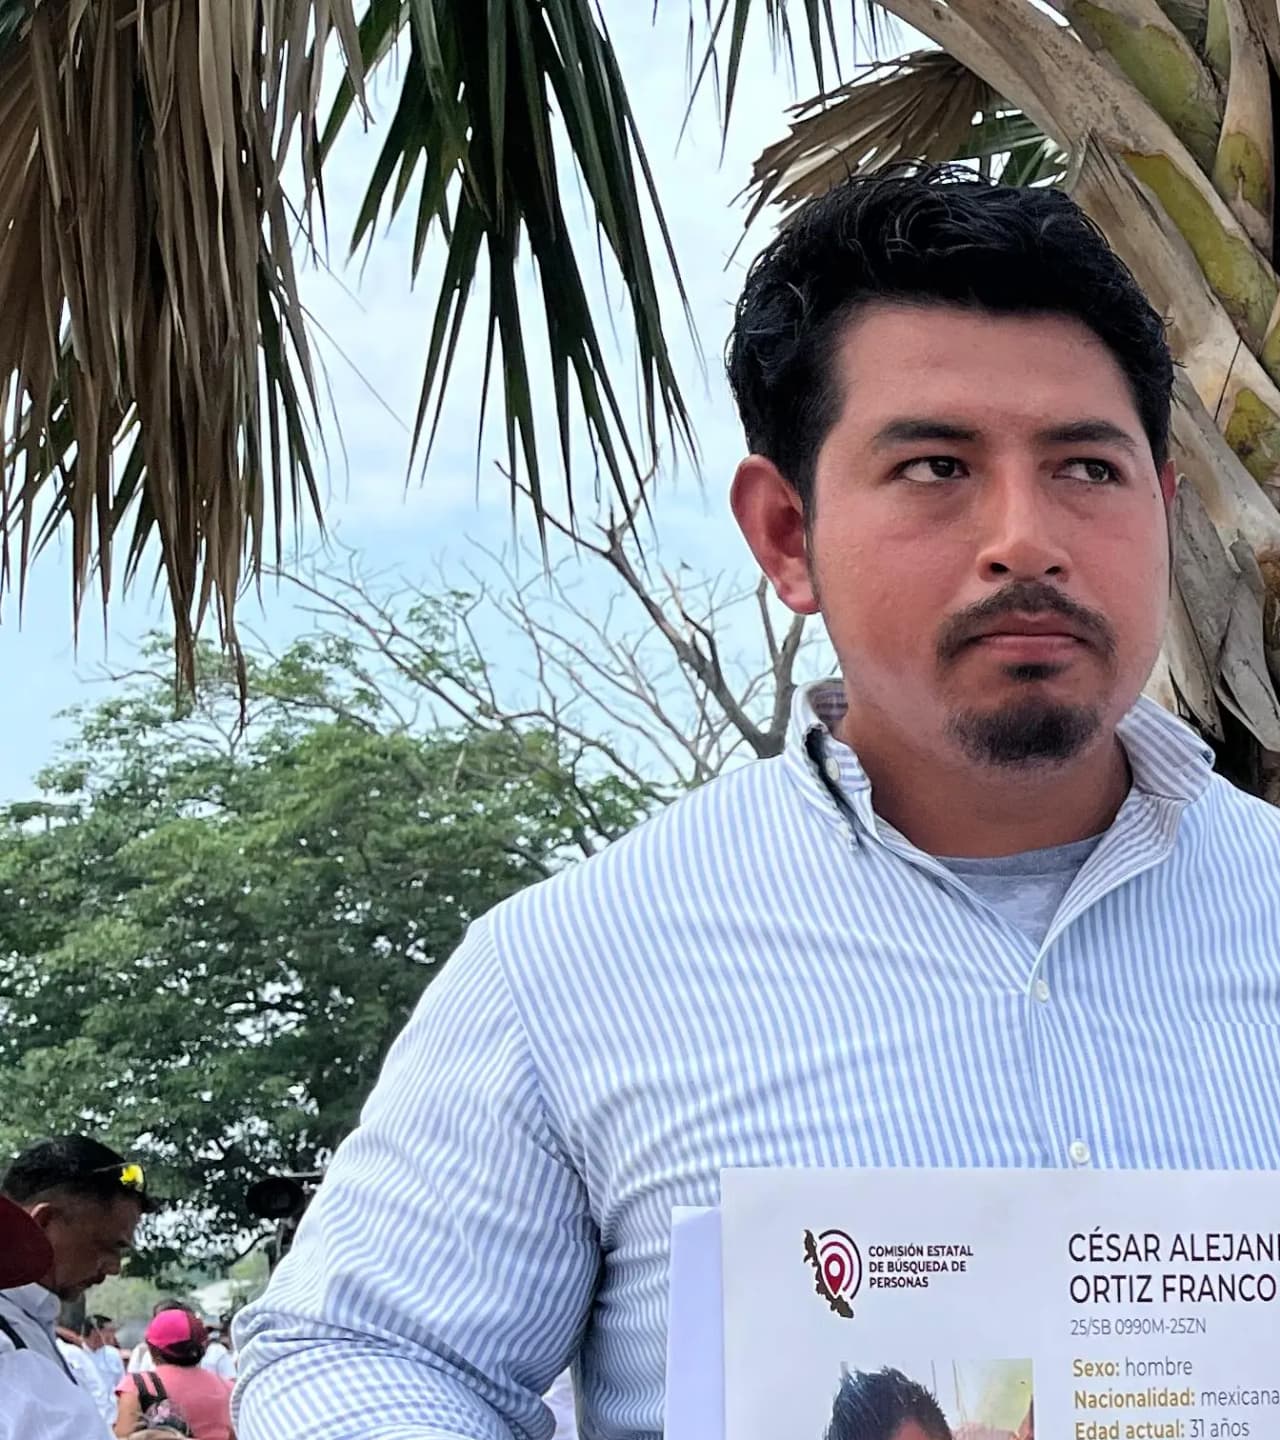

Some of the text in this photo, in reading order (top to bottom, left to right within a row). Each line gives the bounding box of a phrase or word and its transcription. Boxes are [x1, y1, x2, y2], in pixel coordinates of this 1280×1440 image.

[868, 1243, 974, 1257] COMISIÓN ESTATAL
[1068, 1225, 1160, 1262] CÉSAR
[868, 1258, 967, 1275] DE BÚSQUEDA DE
[869, 1276, 929, 1288] PERSONAS
[1069, 1273, 1276, 1304] ORTIZ FRANCO
[1070, 1317, 1206, 1336] 25/SB 0990M-25ZN
[1072, 1355, 1192, 1377] Sexo: hombre
[1074, 1386, 1280, 1409] Nacionalidad: mexicana
[1075, 1417, 1250, 1440] Edad actual: 31 años
